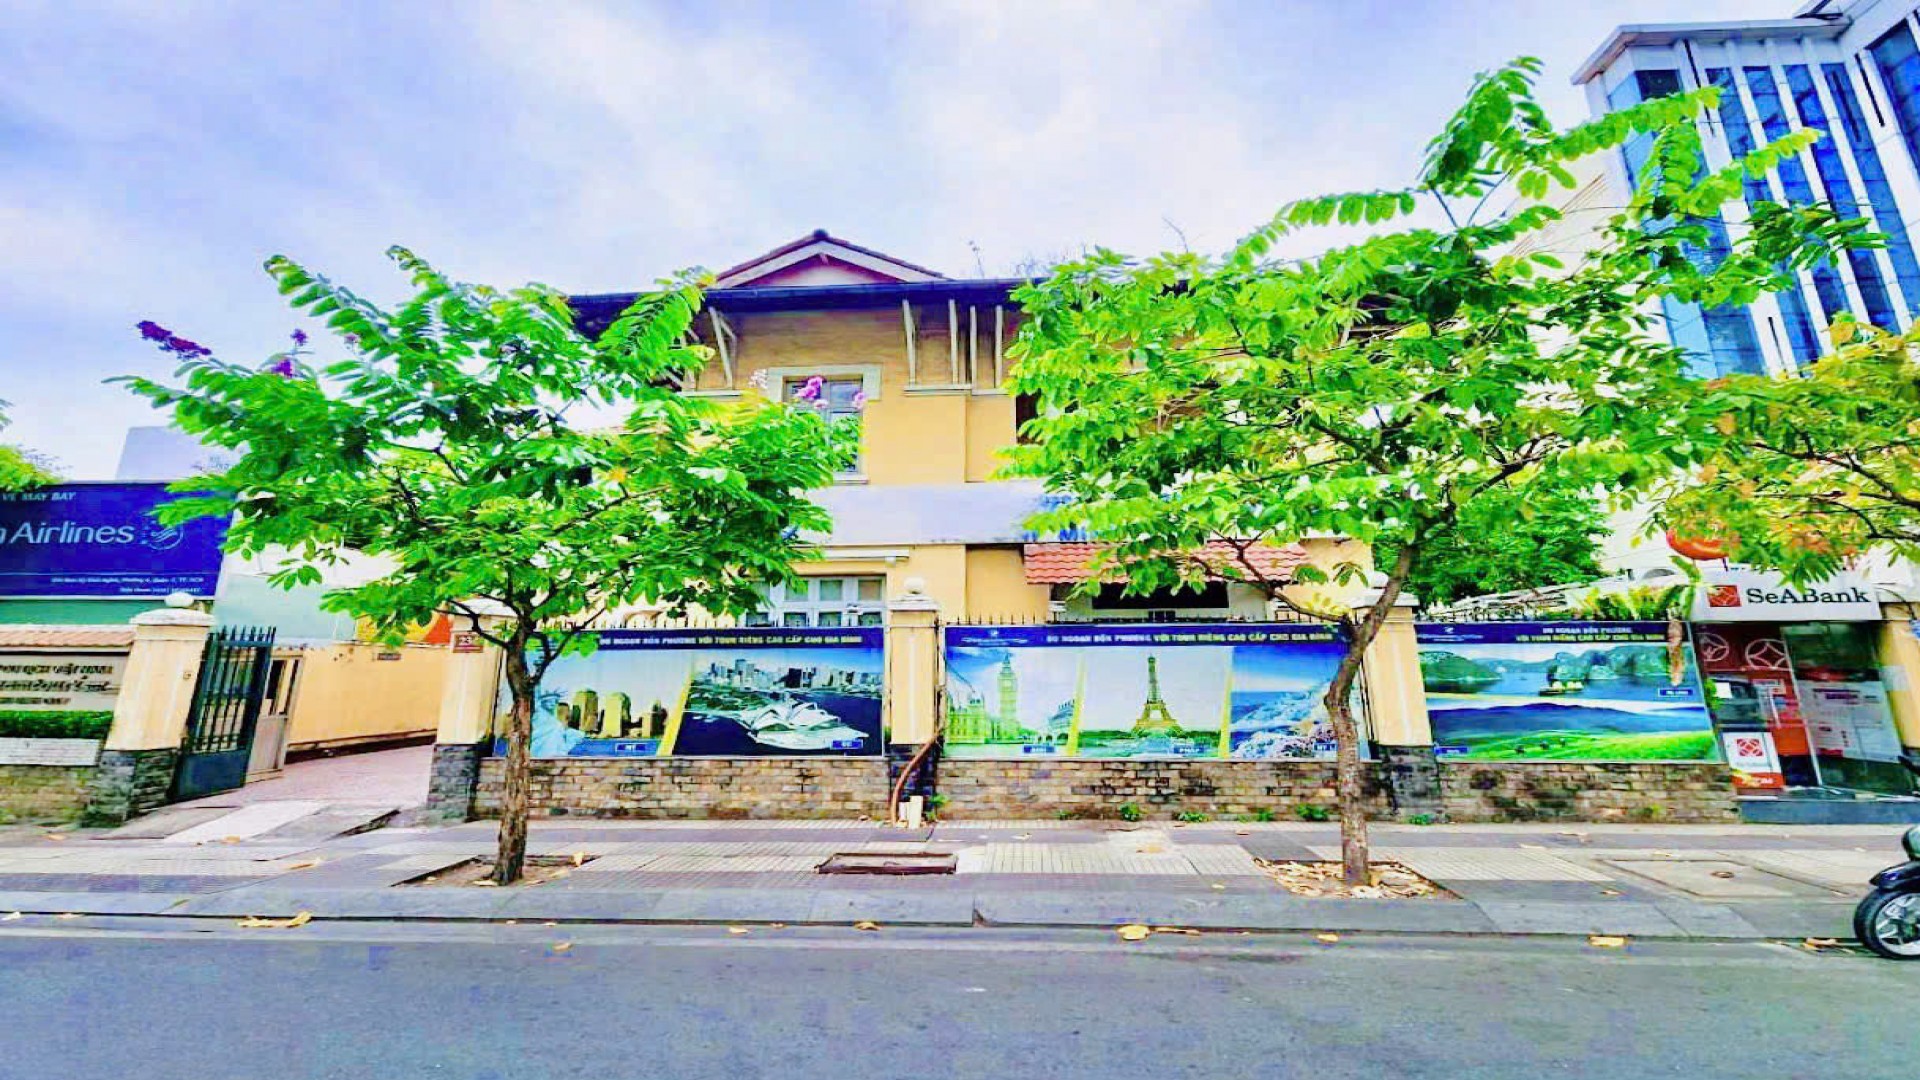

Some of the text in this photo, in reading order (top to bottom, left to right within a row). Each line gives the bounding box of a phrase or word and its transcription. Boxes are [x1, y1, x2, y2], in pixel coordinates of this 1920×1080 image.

[51, 491, 77, 501] BAY
[8, 520, 135, 544] Airlines
[1746, 586, 1871, 604] SeABank
